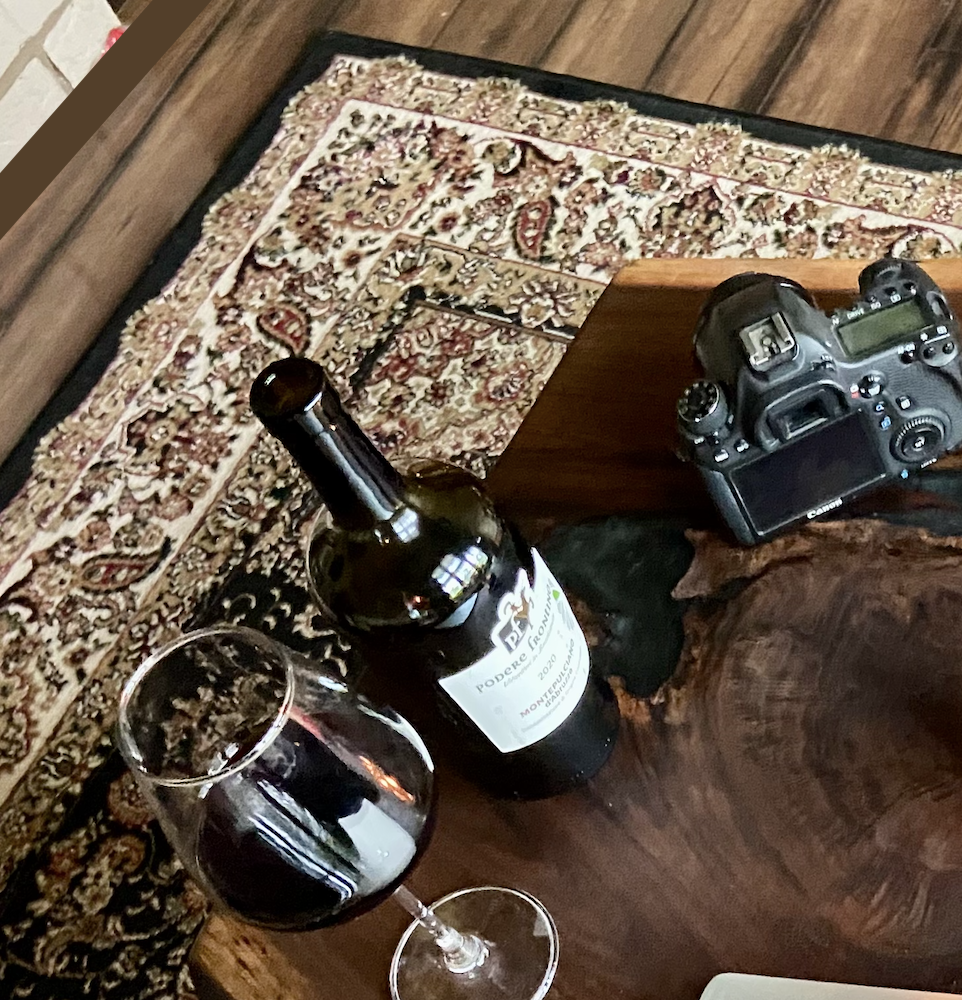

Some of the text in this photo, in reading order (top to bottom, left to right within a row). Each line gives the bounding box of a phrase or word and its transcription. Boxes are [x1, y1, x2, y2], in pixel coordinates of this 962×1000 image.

[806, 497, 842, 519] Canon
[519, 638, 575, 719] MONTEPULCIANO
[538, 653, 557, 681] 2020
[545, 668, 573, 708] d'Abruzzo
